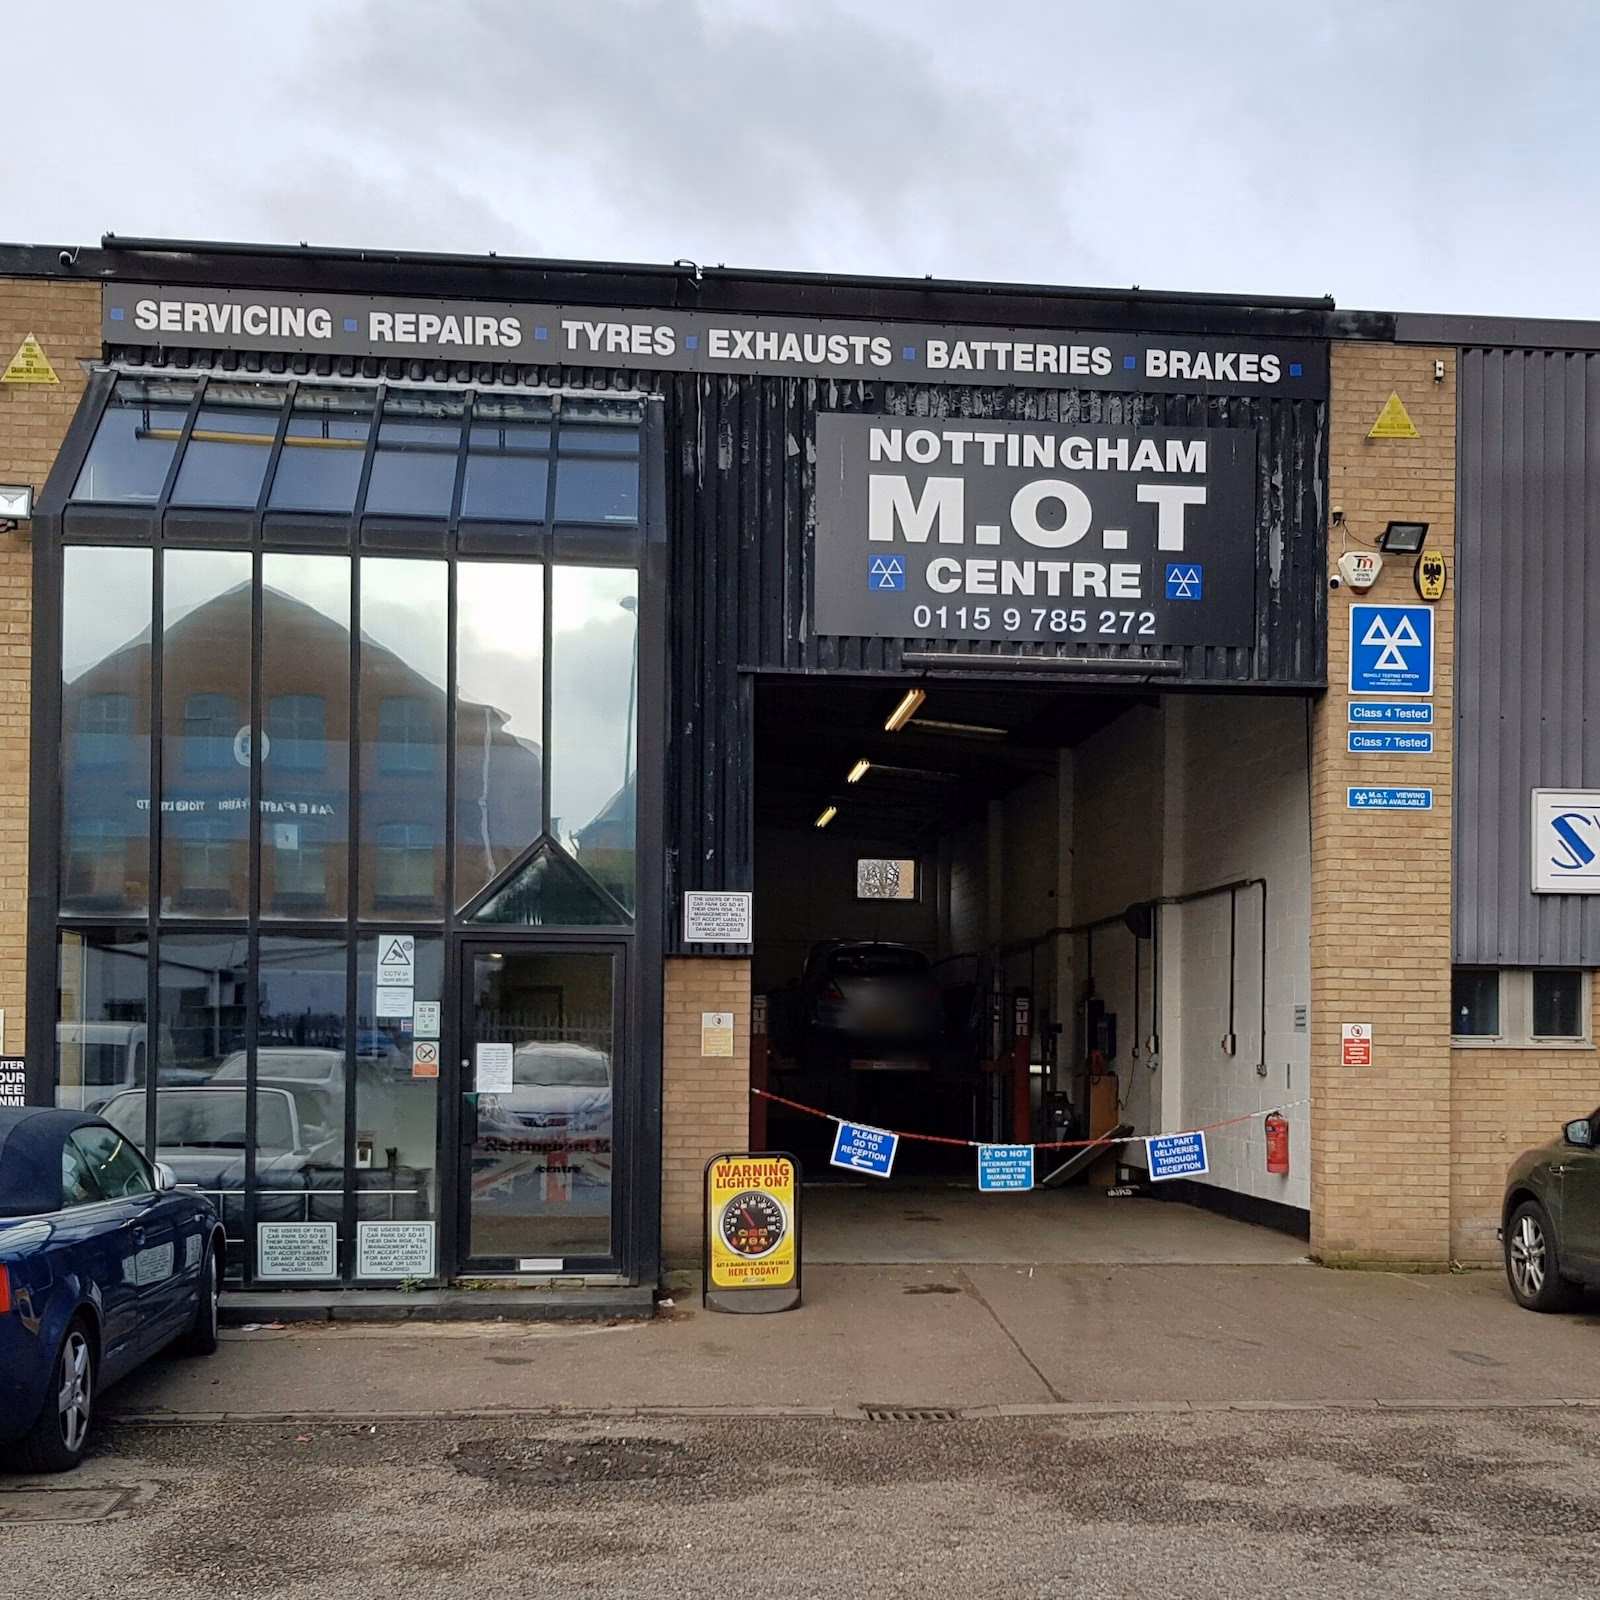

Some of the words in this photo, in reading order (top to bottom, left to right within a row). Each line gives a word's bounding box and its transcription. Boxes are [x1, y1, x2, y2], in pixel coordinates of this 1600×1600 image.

[134, 299, 332, 339] SERVICING
[369, 311, 522, 347] REPAIRS
[561, 320, 676, 356] TYRES
[708, 328, 892, 366] EXHAUSTS
[926, 340, 1112, 376] BATTERIES
[1145, 349, 1281, 383] BRAKES
[869, 427, 1207, 473] NOTTINGHAM
[925, 557, 1142, 599] CENTRE
[913, 604, 991, 630] 0115
[1003, 608, 1021, 631] 9
[1030, 608, 1087, 633] 785
[1098, 610, 1156, 635] 272
[1353, 708, 1382, 718] Class
[1385, 708, 1392, 718] 4
[1394, 708, 1428, 718] Tested
[1353, 737, 1382, 747] Class
[1385, 737, 1392, 746] 7
[1394, 737, 1428, 748] Tested
[852, 1129, 884, 1144] PLEASE
[1174, 1137, 1194, 1145] PART
[853, 1139, 866, 1148] GO
[868, 1142, 878, 1151] TO
[1154, 1145, 1199, 1157] DELIVERIES
[841, 1145, 886, 1162] RECEPTION
[1158, 1154, 1197, 1165] THROUGH
[716, 1164, 789, 1177] WARNING
[1156, 1162, 1201, 1174] RECEPTION
[716, 1177, 760, 1188] LIGHTS
[765, 1177, 789, 1187] ON?
[728, 1268, 748, 1276] HERE
[750, 1267, 778, 1275] TODAY!
